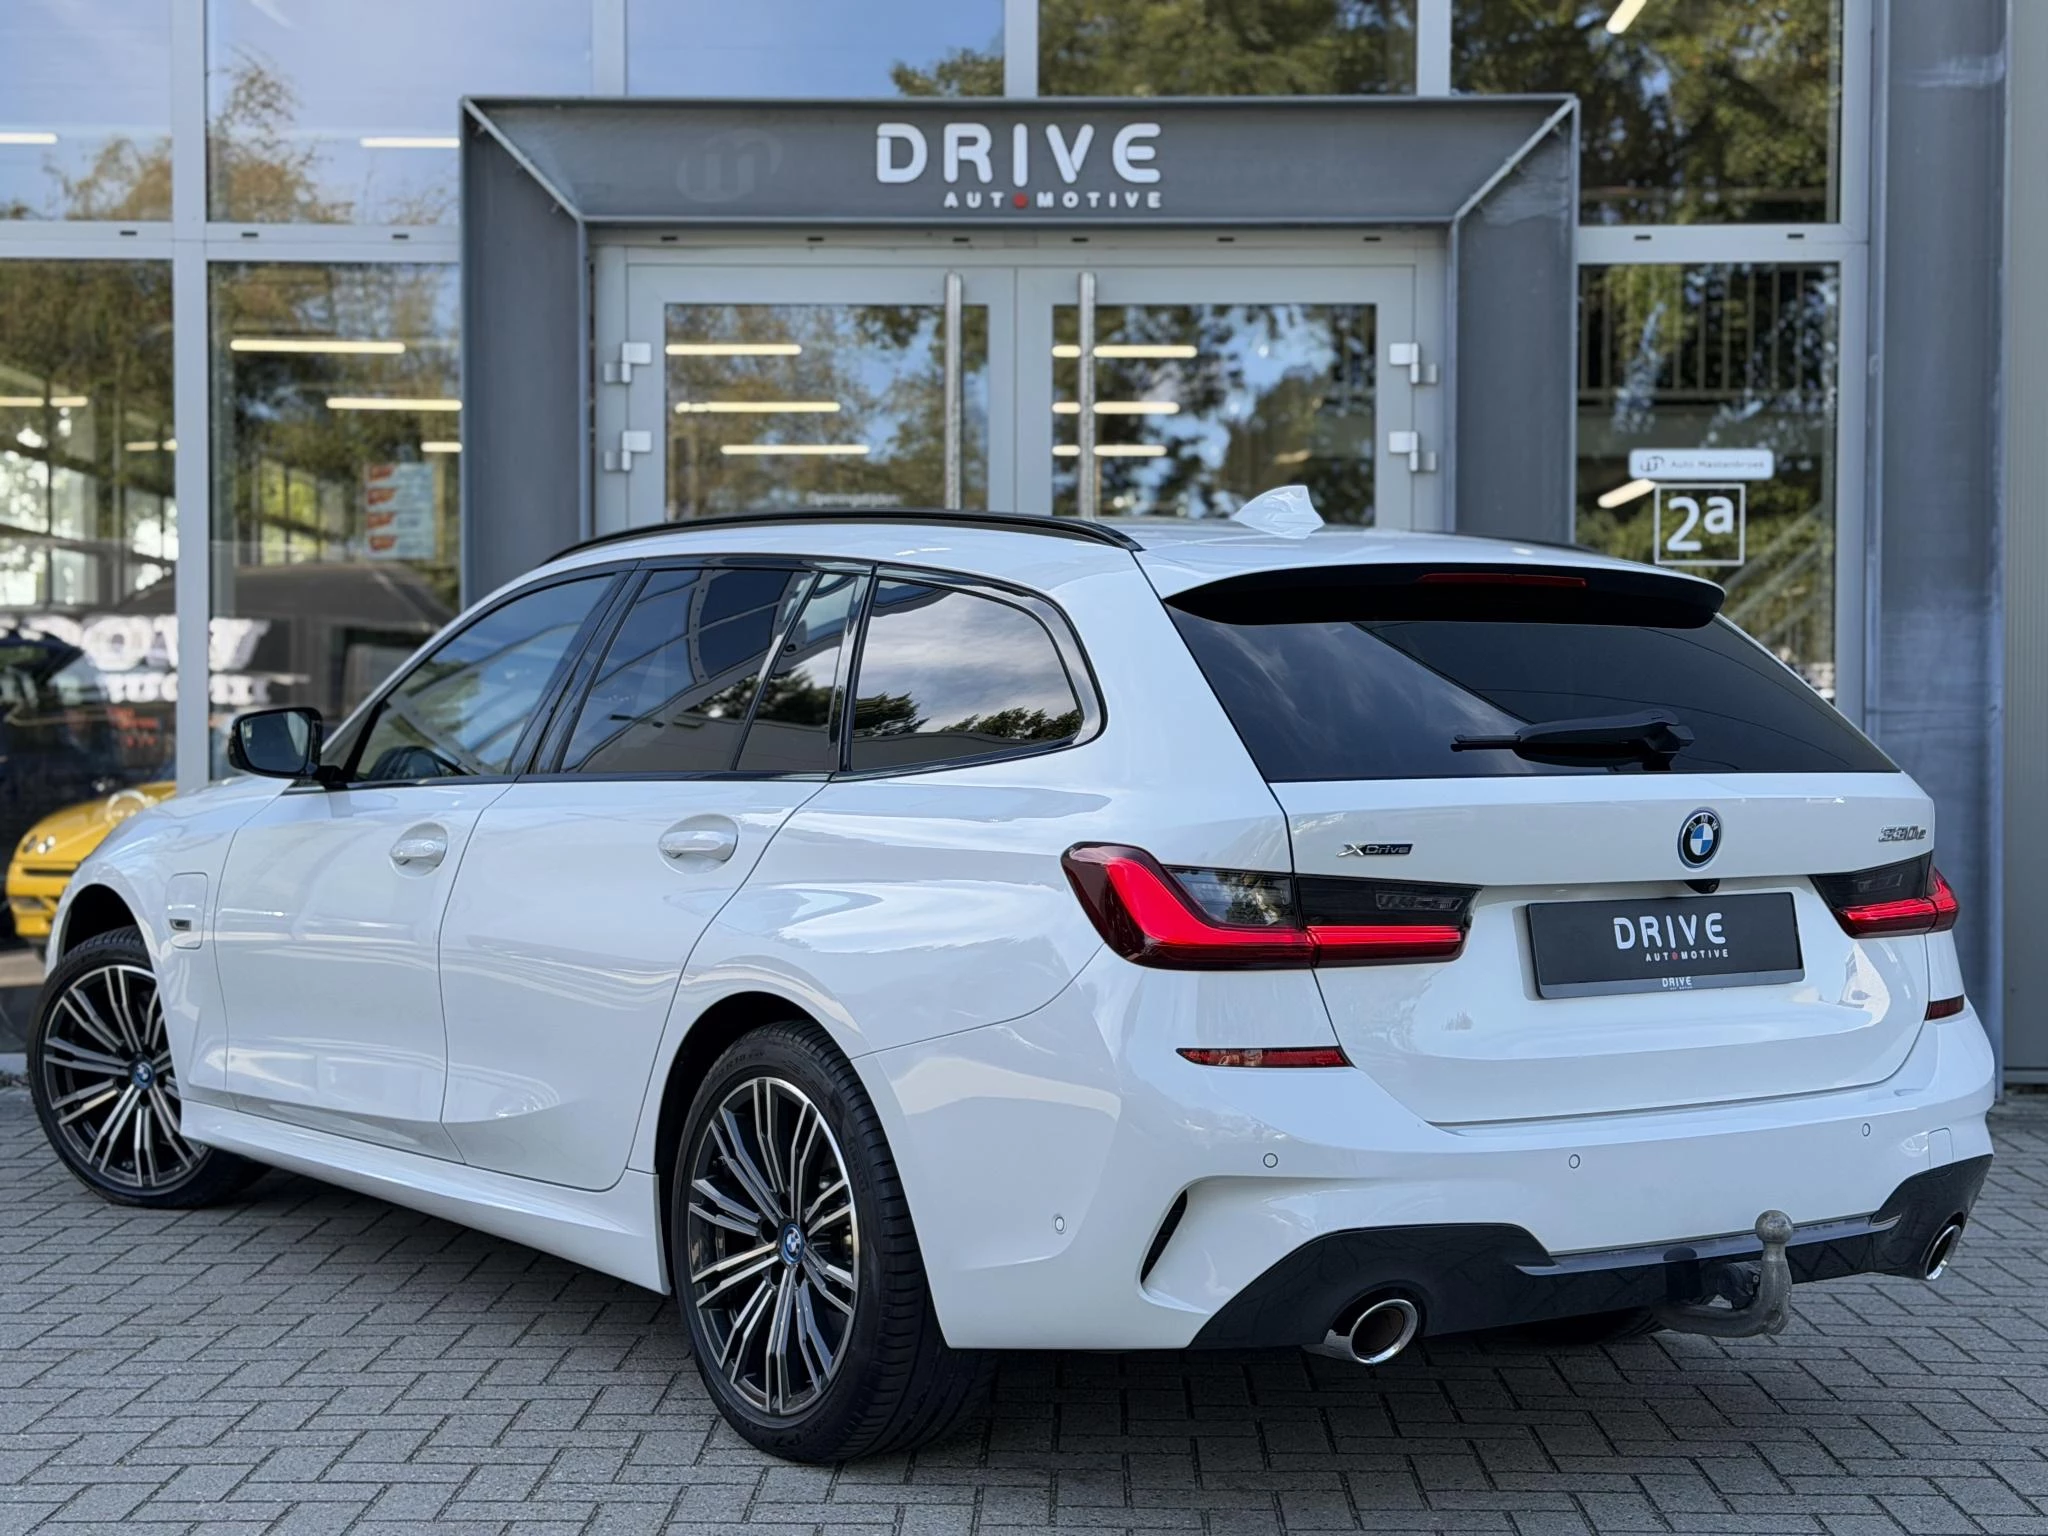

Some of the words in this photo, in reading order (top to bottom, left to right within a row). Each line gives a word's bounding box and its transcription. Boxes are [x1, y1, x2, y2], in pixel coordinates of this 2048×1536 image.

[876, 122, 1161, 187] DRIVE
[943, 191, 1162, 208] AUTOMOTIVE
[1666, 496, 1735, 551] 2a
[1613, 912, 1726, 950] DRIVE
[1645, 948, 1729, 962] AUTOMOTIVE
[1661, 976, 1692, 988] DRIVE
